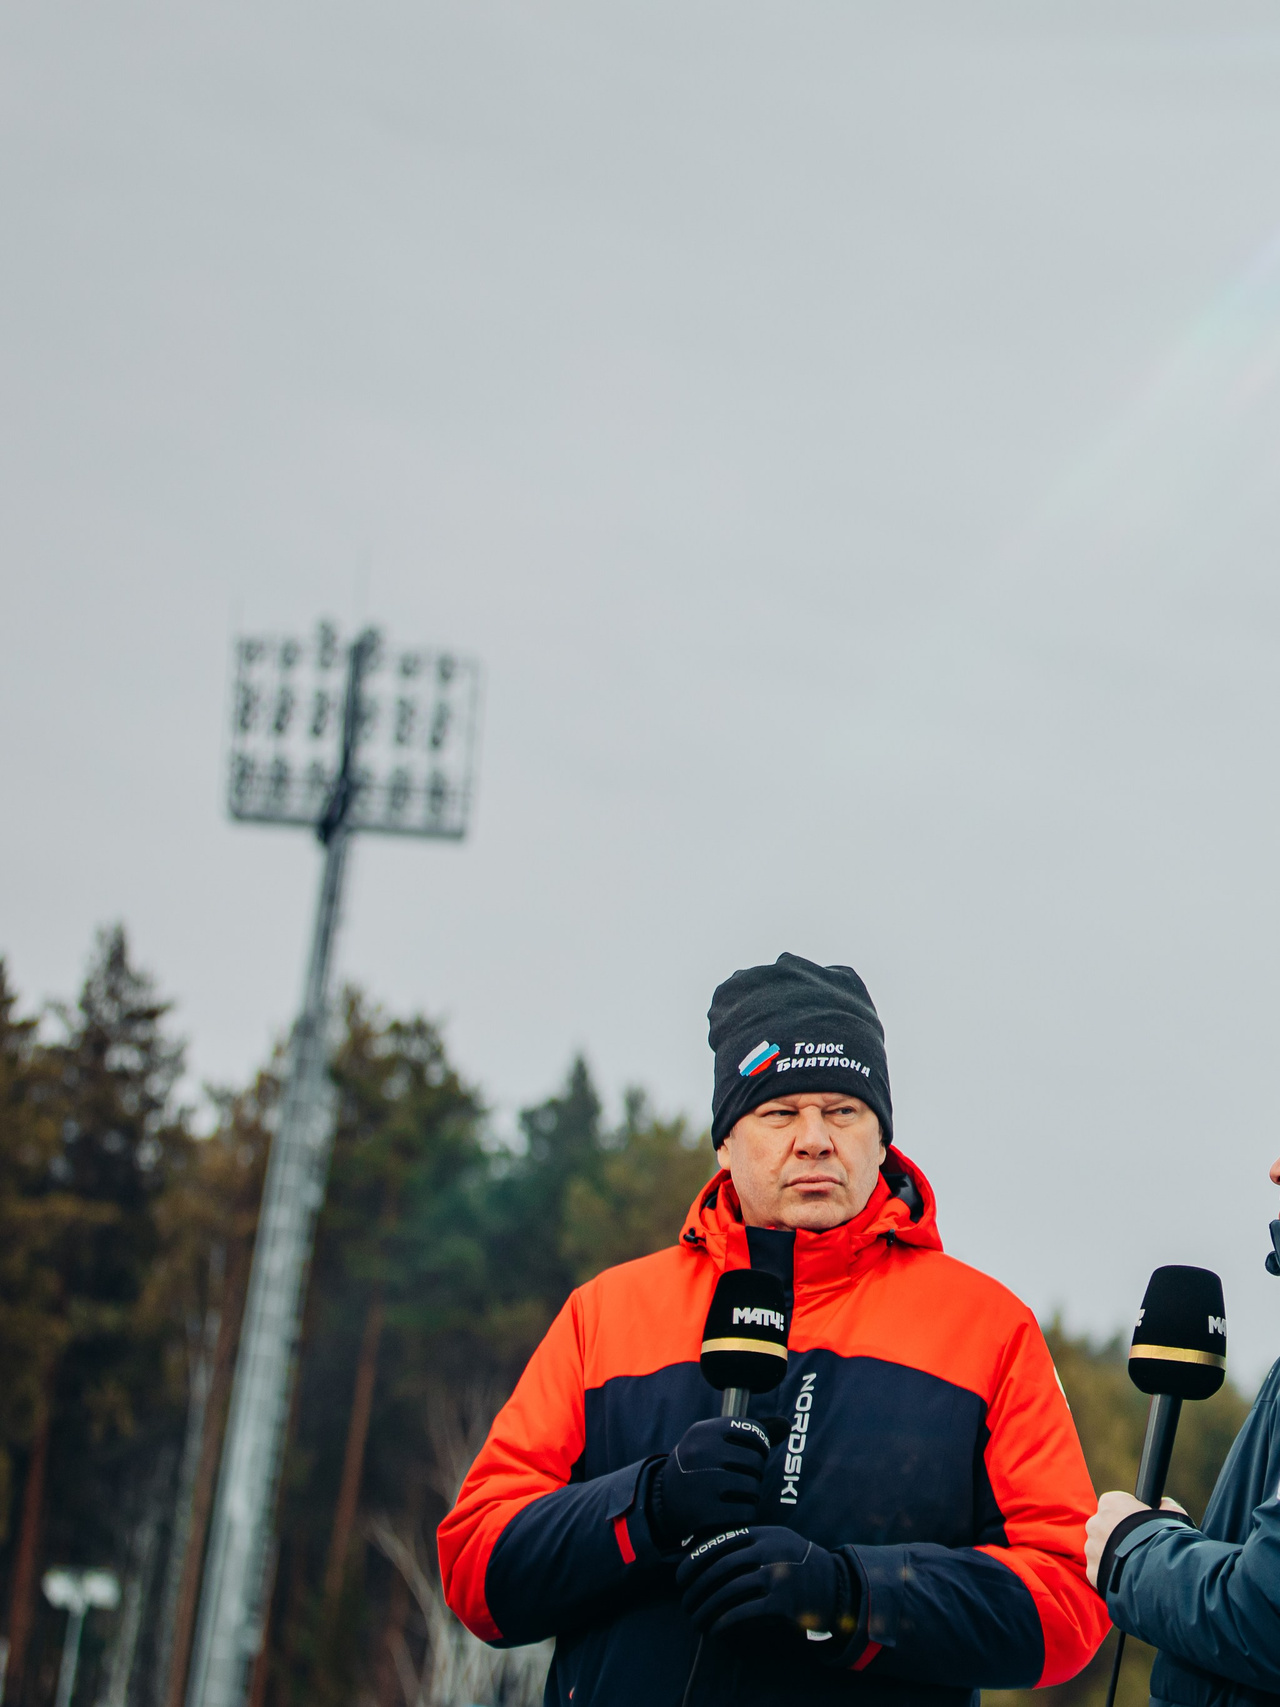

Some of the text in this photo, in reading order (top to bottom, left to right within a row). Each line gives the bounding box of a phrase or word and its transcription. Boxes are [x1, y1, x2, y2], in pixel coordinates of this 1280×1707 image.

[730, 1419, 771, 1450] NORDS
[780, 1372, 817, 1505] NORDSKI
[690, 1527, 750, 1560] NORDSKI
